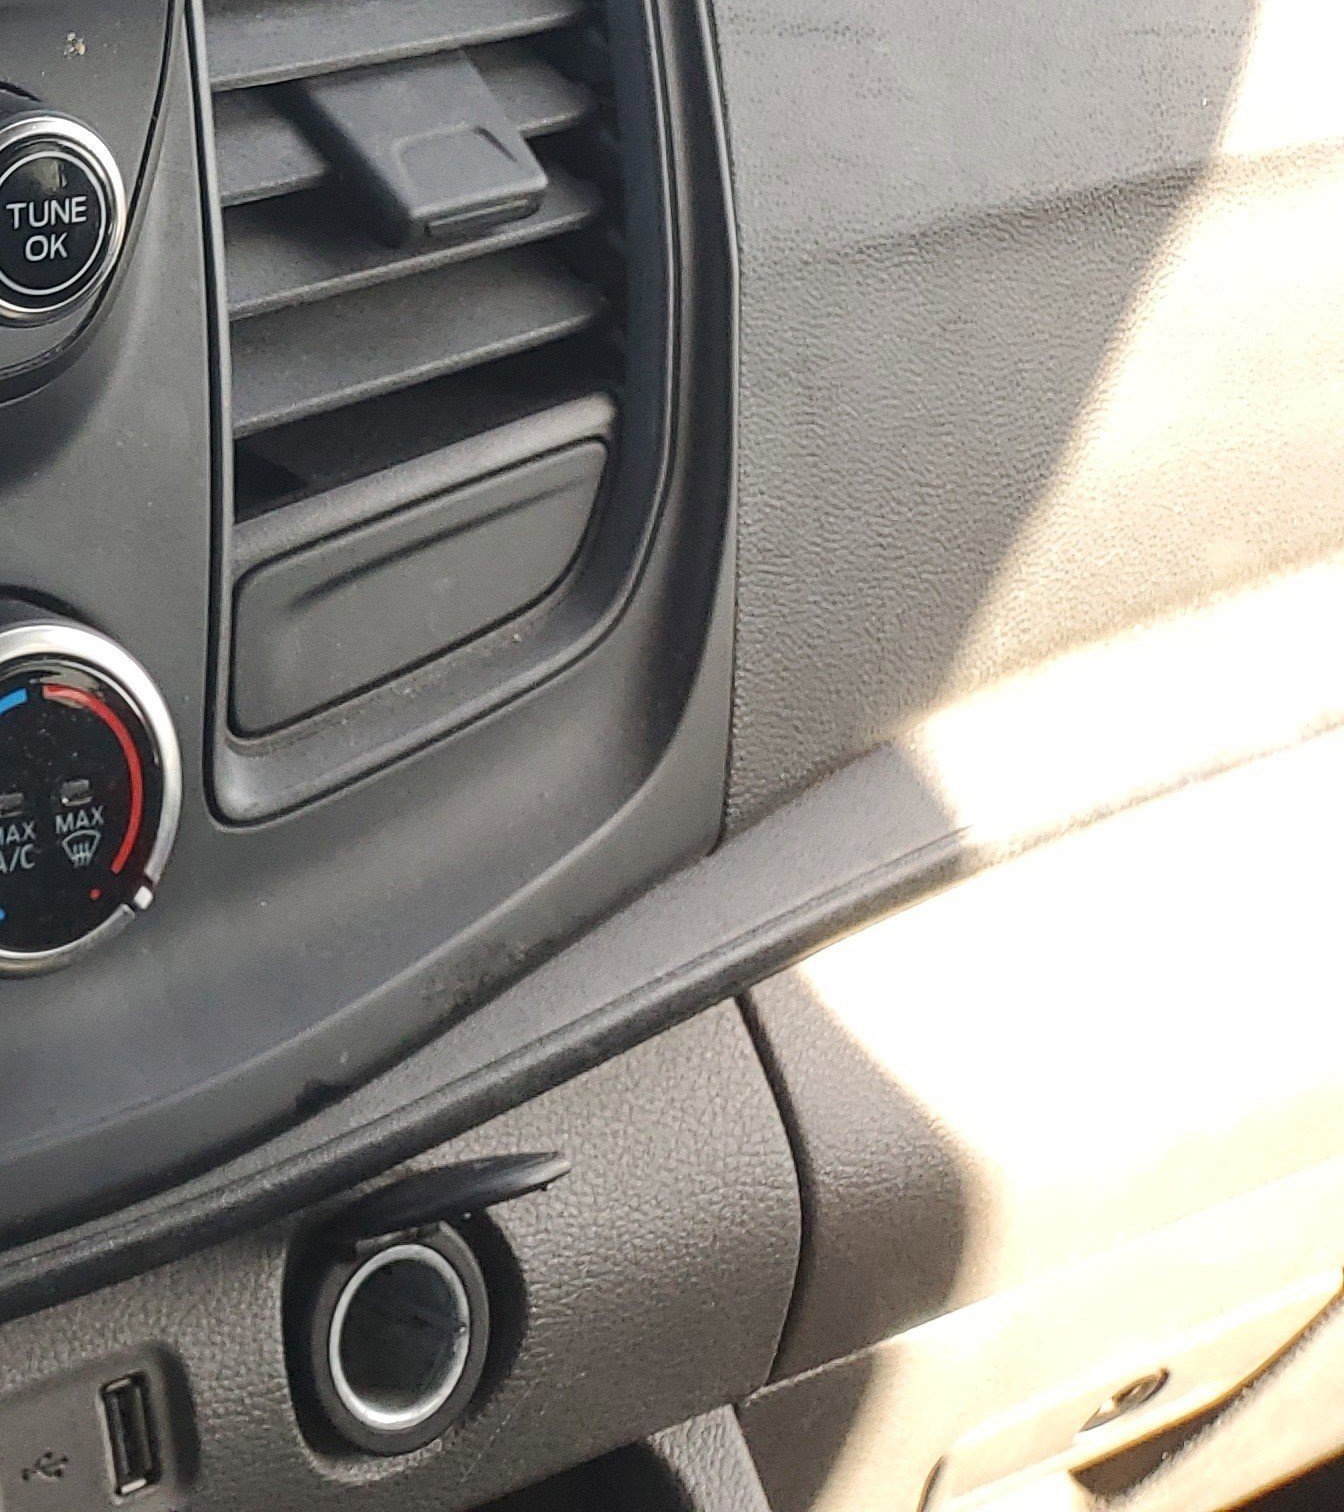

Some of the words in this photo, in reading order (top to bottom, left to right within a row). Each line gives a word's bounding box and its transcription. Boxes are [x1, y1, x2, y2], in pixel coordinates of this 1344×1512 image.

[5, 196, 86, 228] TUNE
[24, 232, 69, 264] OK
[55, 806, 104, 833] MAX
